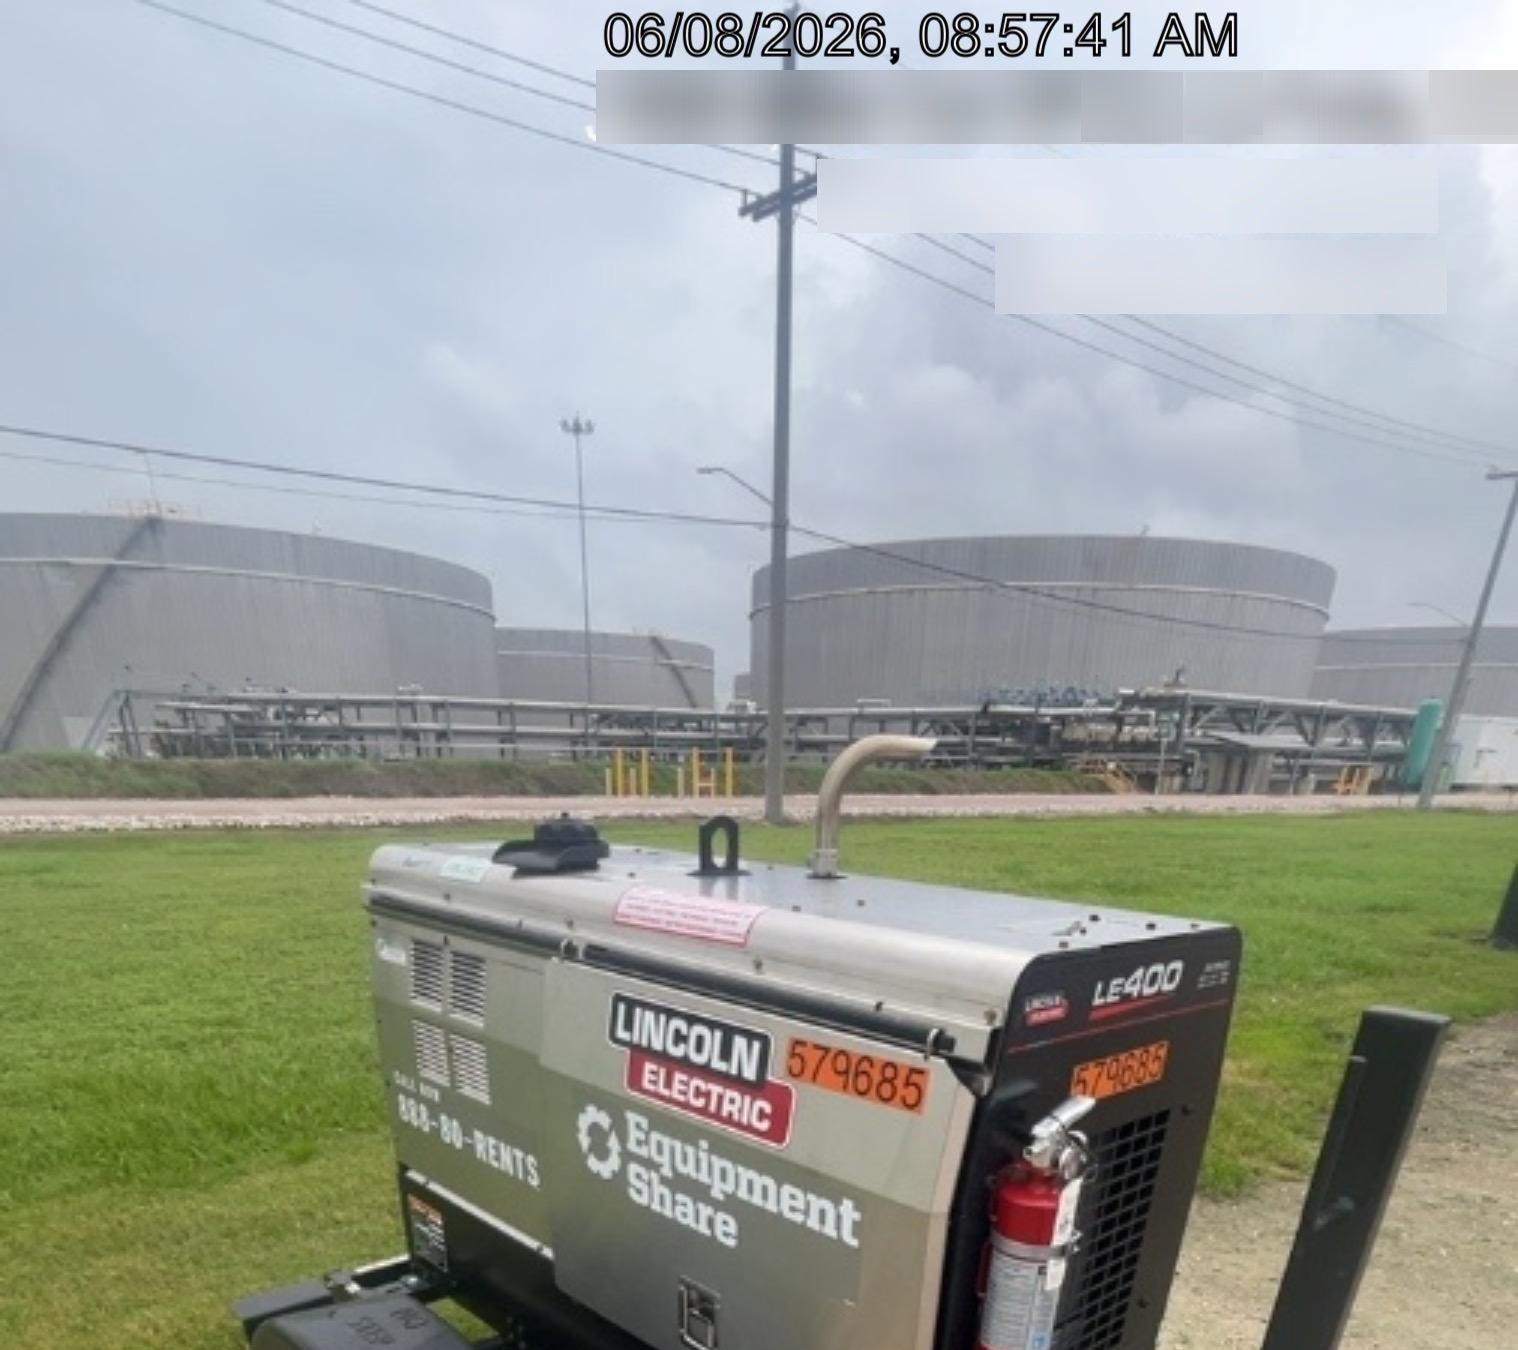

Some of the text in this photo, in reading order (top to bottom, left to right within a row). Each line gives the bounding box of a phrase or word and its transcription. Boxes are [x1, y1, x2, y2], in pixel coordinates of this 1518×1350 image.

[1092, 960, 1184, 1006] LE400
[614, 1001, 762, 1082] LINCOLN
[786, 1038, 926, 1111] 579685
[1073, 1044, 1167, 1098] 579685
[641, 1061, 773, 1132] ELECTRIC
[625, 1109, 862, 1248] Equipment
[626, 1162, 739, 1248] Share
